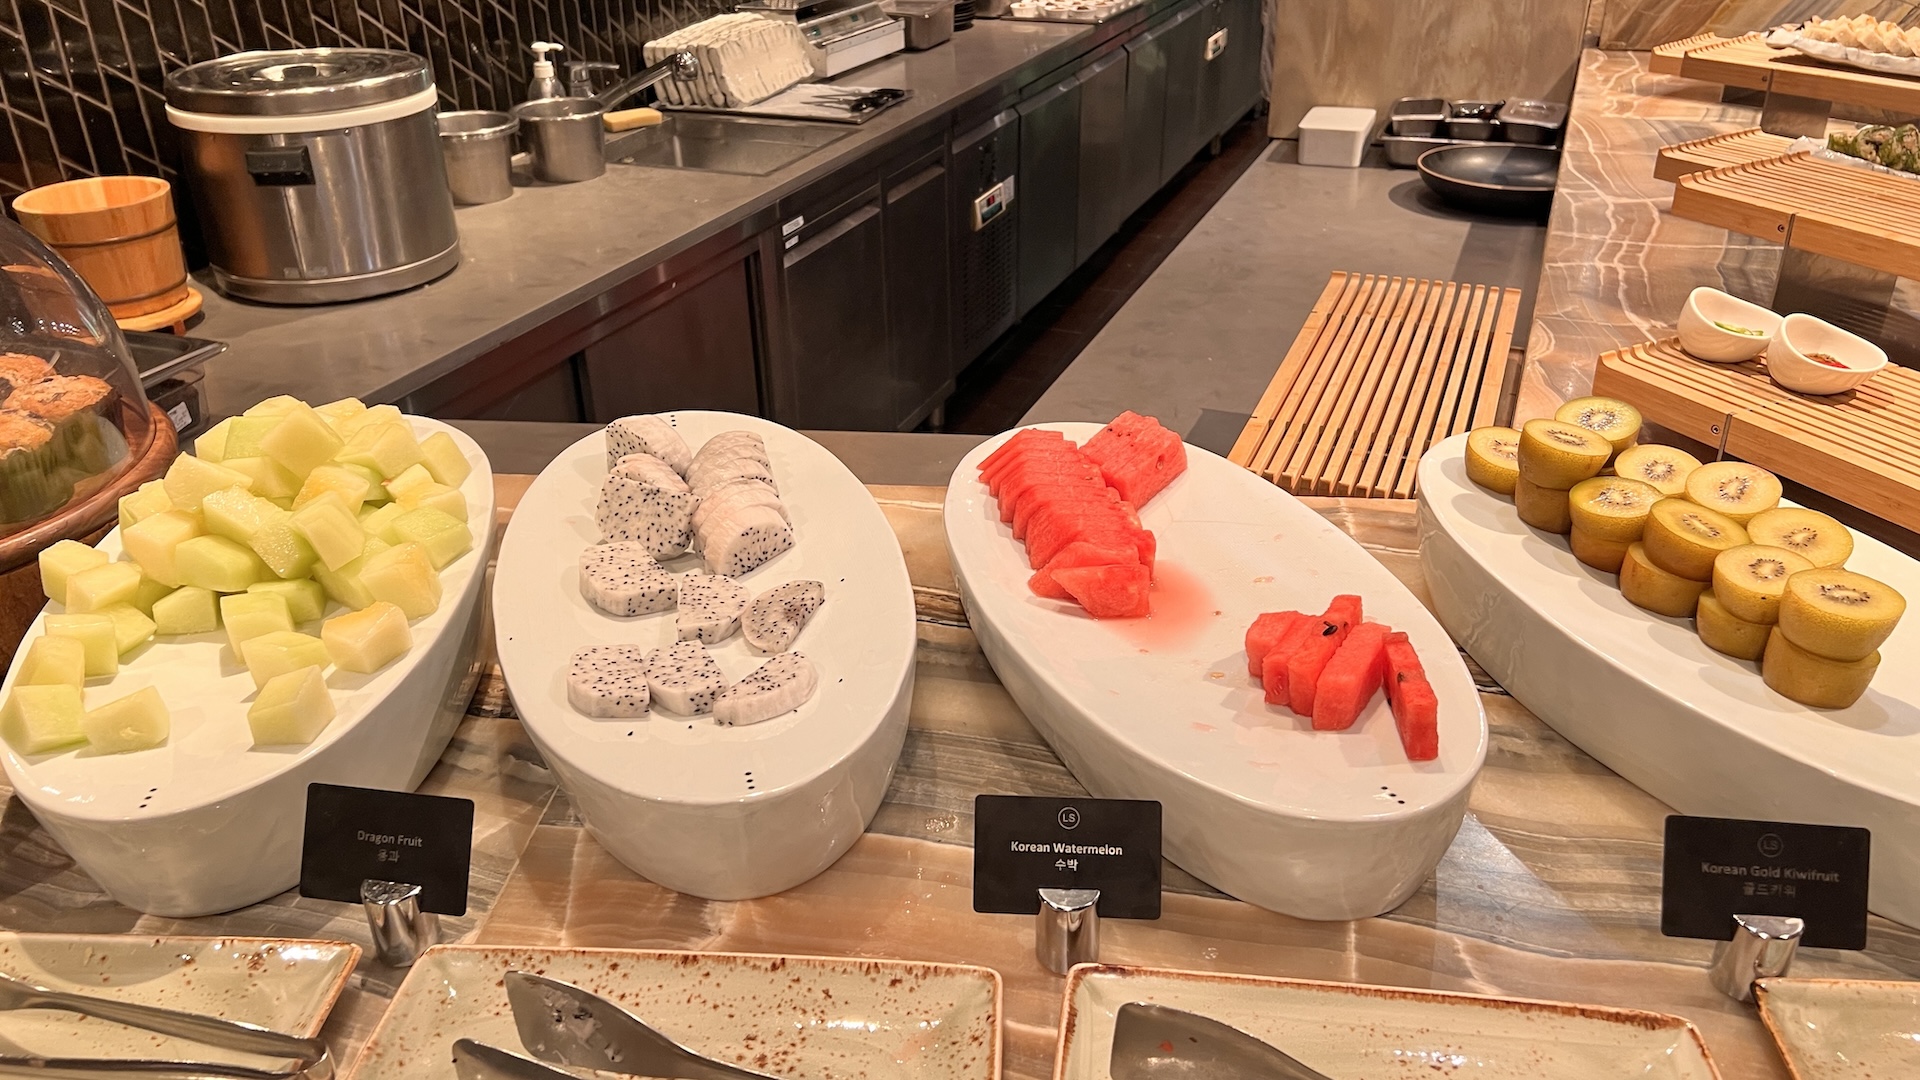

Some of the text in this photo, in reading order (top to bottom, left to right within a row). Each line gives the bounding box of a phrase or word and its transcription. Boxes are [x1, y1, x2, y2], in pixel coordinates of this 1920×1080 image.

[1062, 813, 1076, 823] LS
[357, 830, 423, 848] Dragon Fruit
[1011, 840, 1123, 856] Korean Watermelon
[376, 849, 401, 863] 용과
[1054, 858, 1079, 872] 수박
[1700, 862, 1841, 883] Korean Gold Kiwifruit
